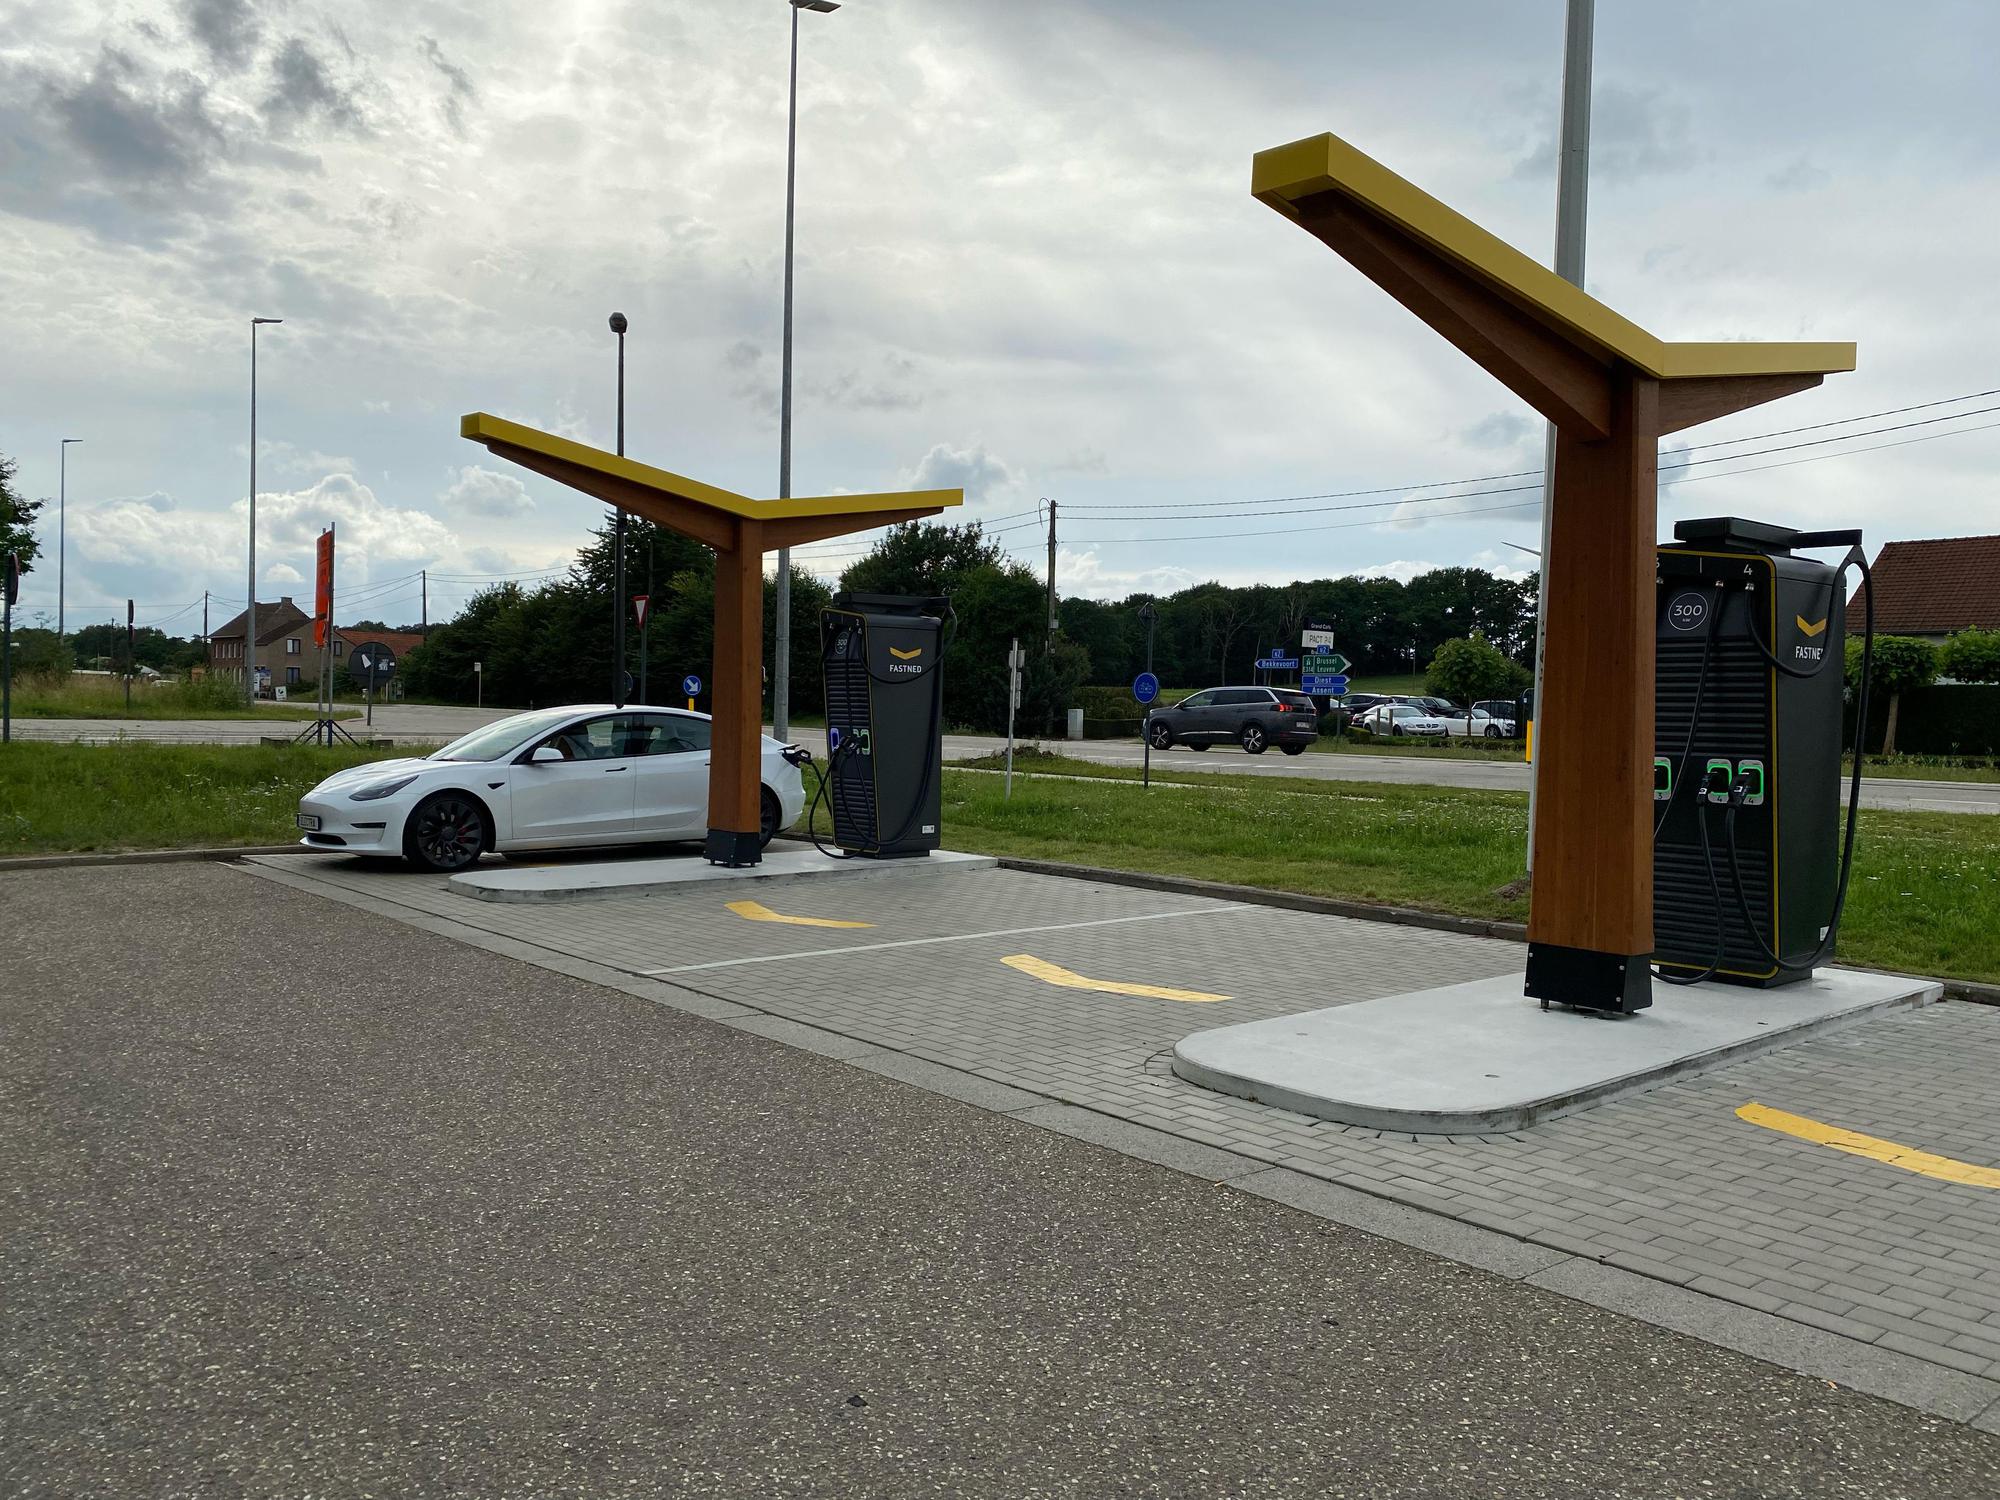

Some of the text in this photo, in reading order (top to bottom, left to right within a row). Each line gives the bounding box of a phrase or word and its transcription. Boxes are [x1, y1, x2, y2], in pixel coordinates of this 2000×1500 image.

[1743, 564, 1753, 576] 4
[1673, 605, 1703, 616] 300
[1316, 657, 1337, 665] Brussel
[889, 664, 922, 673] FASTNED
[1314, 676, 1332, 684] Diest
